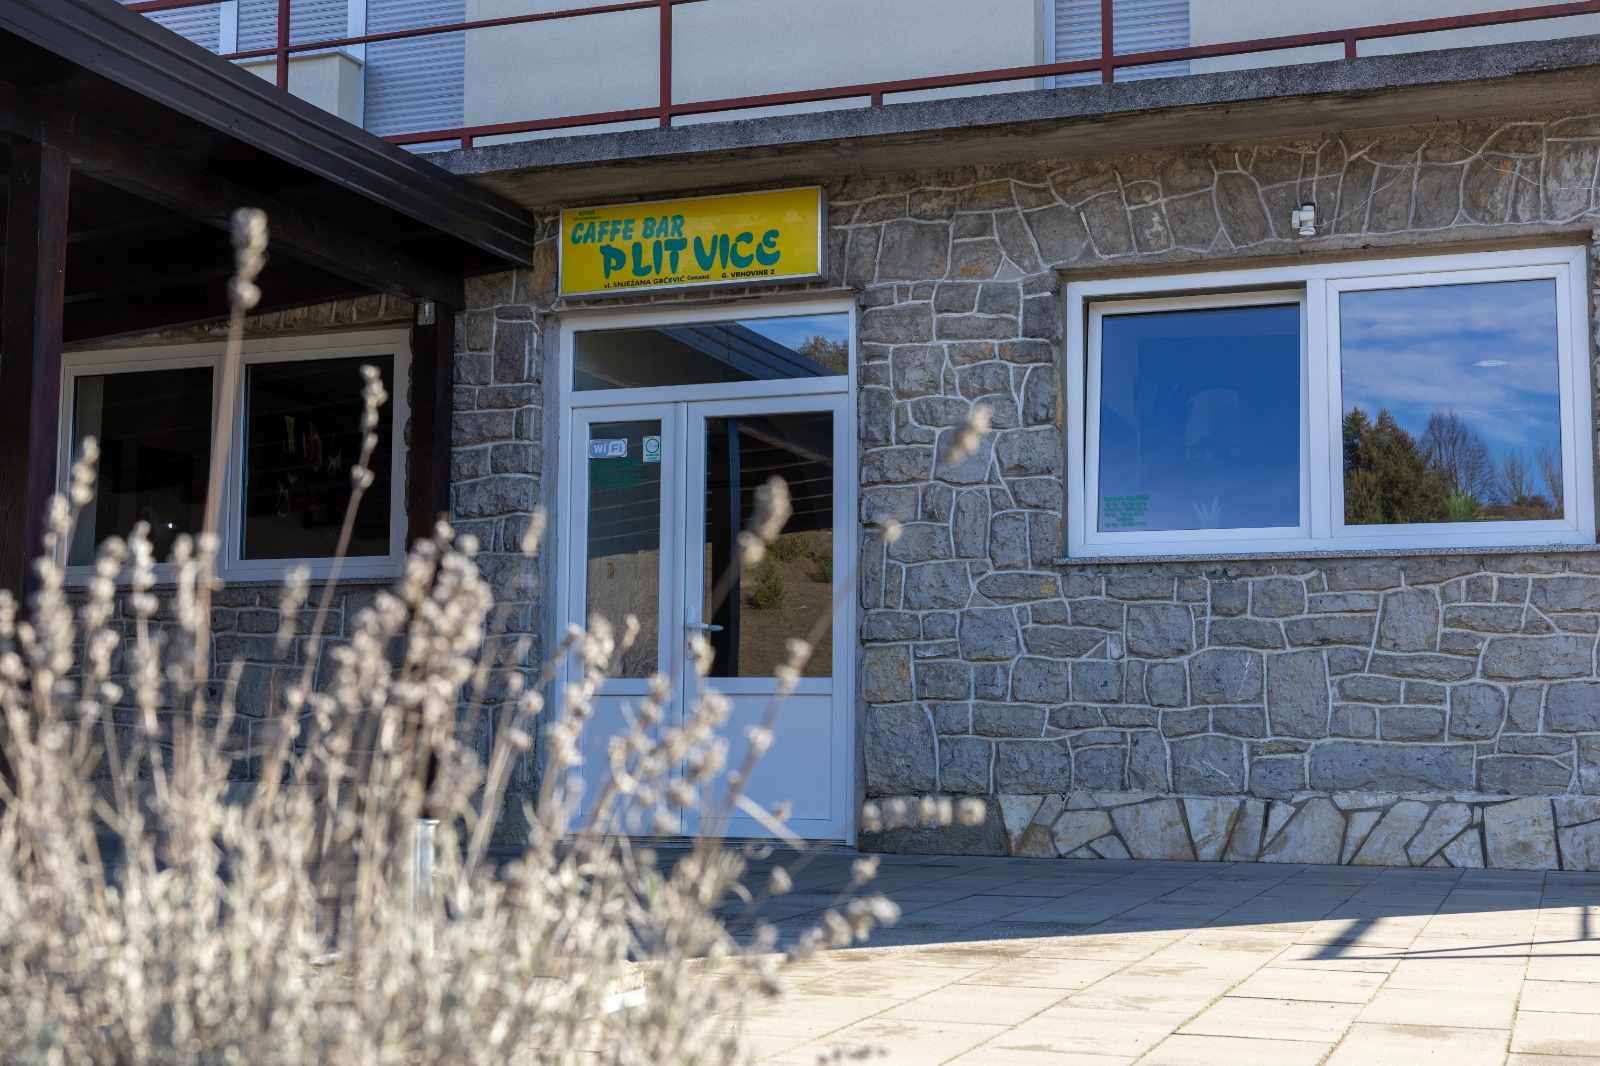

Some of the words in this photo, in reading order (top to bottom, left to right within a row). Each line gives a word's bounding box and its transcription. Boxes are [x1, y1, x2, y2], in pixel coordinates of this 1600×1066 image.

[571, 219, 636, 245] CAFFE
[641, 214, 685, 239] BAR
[613, 278, 651, 288] SNJEŽANA
[652, 274, 686, 285] GRČEVIĆ
[730, 269, 769, 278] VRHOVINE
